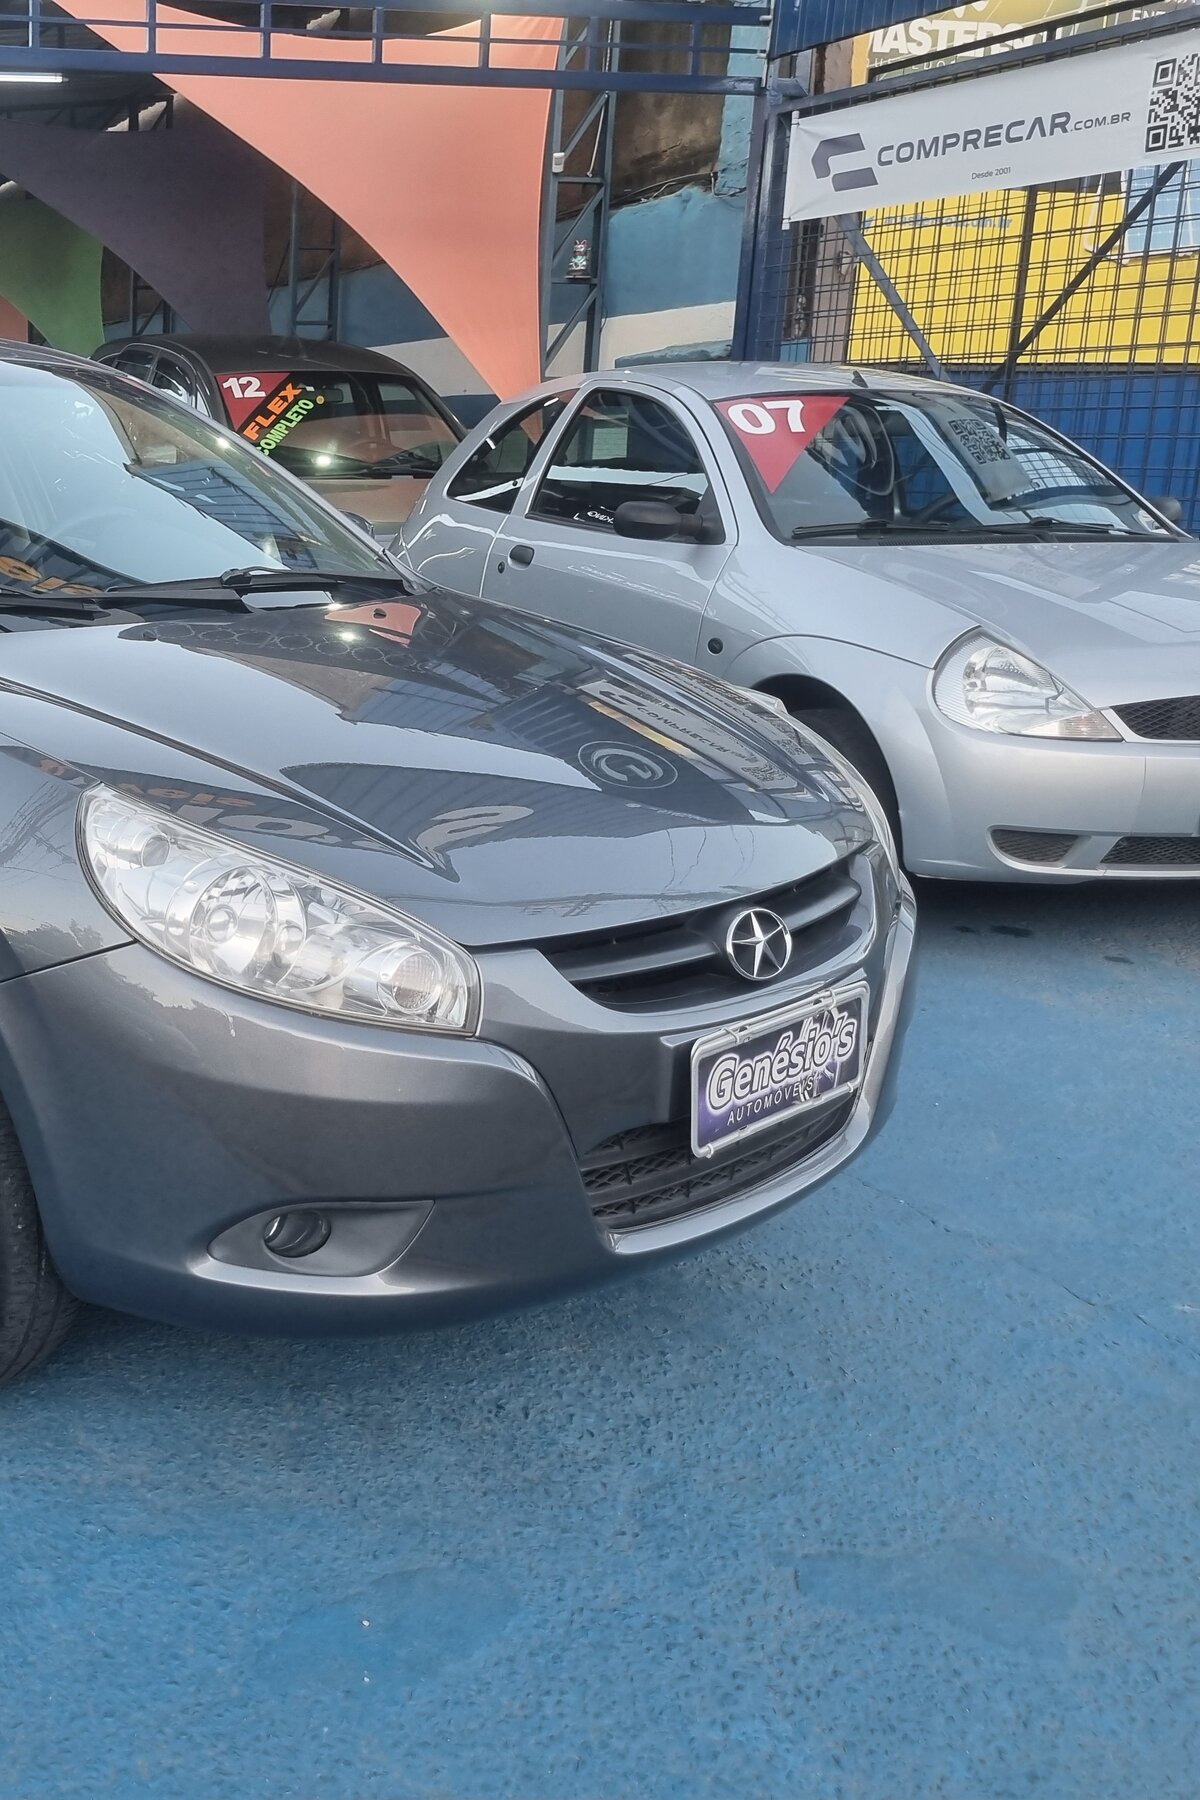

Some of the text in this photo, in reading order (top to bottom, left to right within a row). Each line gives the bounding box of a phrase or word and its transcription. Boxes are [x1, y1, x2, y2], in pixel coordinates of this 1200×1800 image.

[971, 166, 1012, 180] Desde 2001
[222, 376, 267, 399] 12
[242, 382, 302, 441] FLEX
[257, 398, 314, 456] COMPLETO
[727, 399, 806, 435] 07
[708, 1012, 855, 1112] Genésio's
